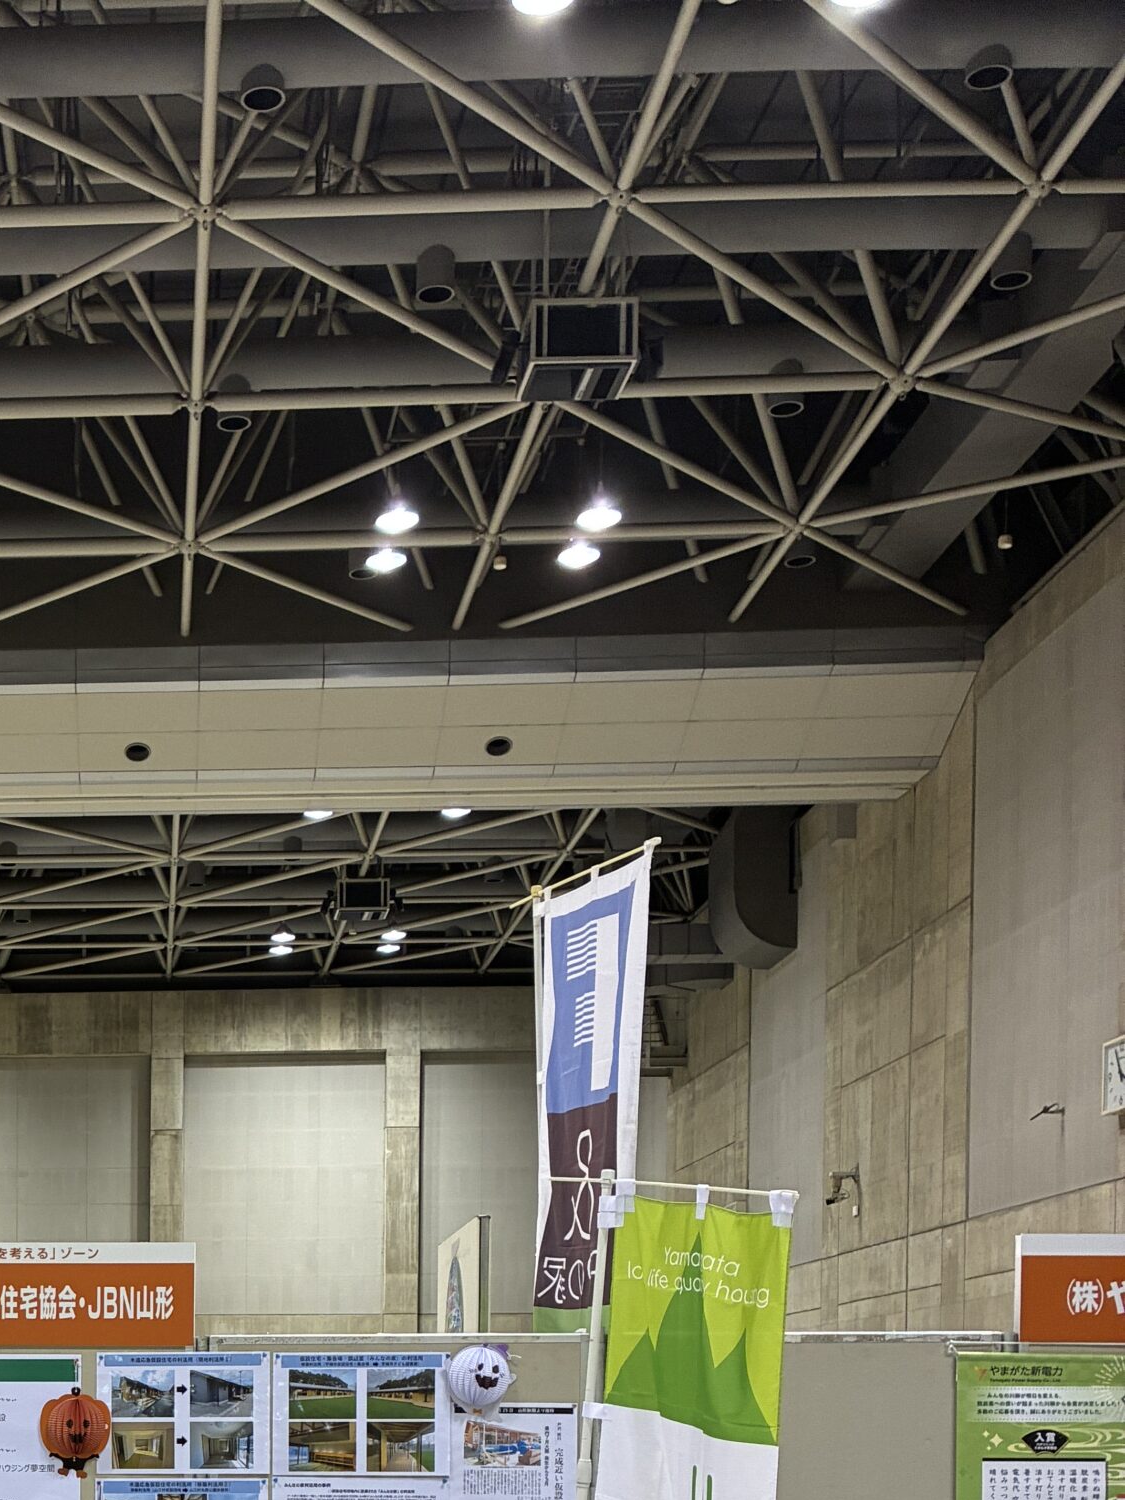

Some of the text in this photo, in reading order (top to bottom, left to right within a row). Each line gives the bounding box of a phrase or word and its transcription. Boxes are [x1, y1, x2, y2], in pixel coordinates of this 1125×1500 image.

[664, 1246, 741, 1277] Yamaata
[990, 1366, 1063, 1377] やまがた新電力
